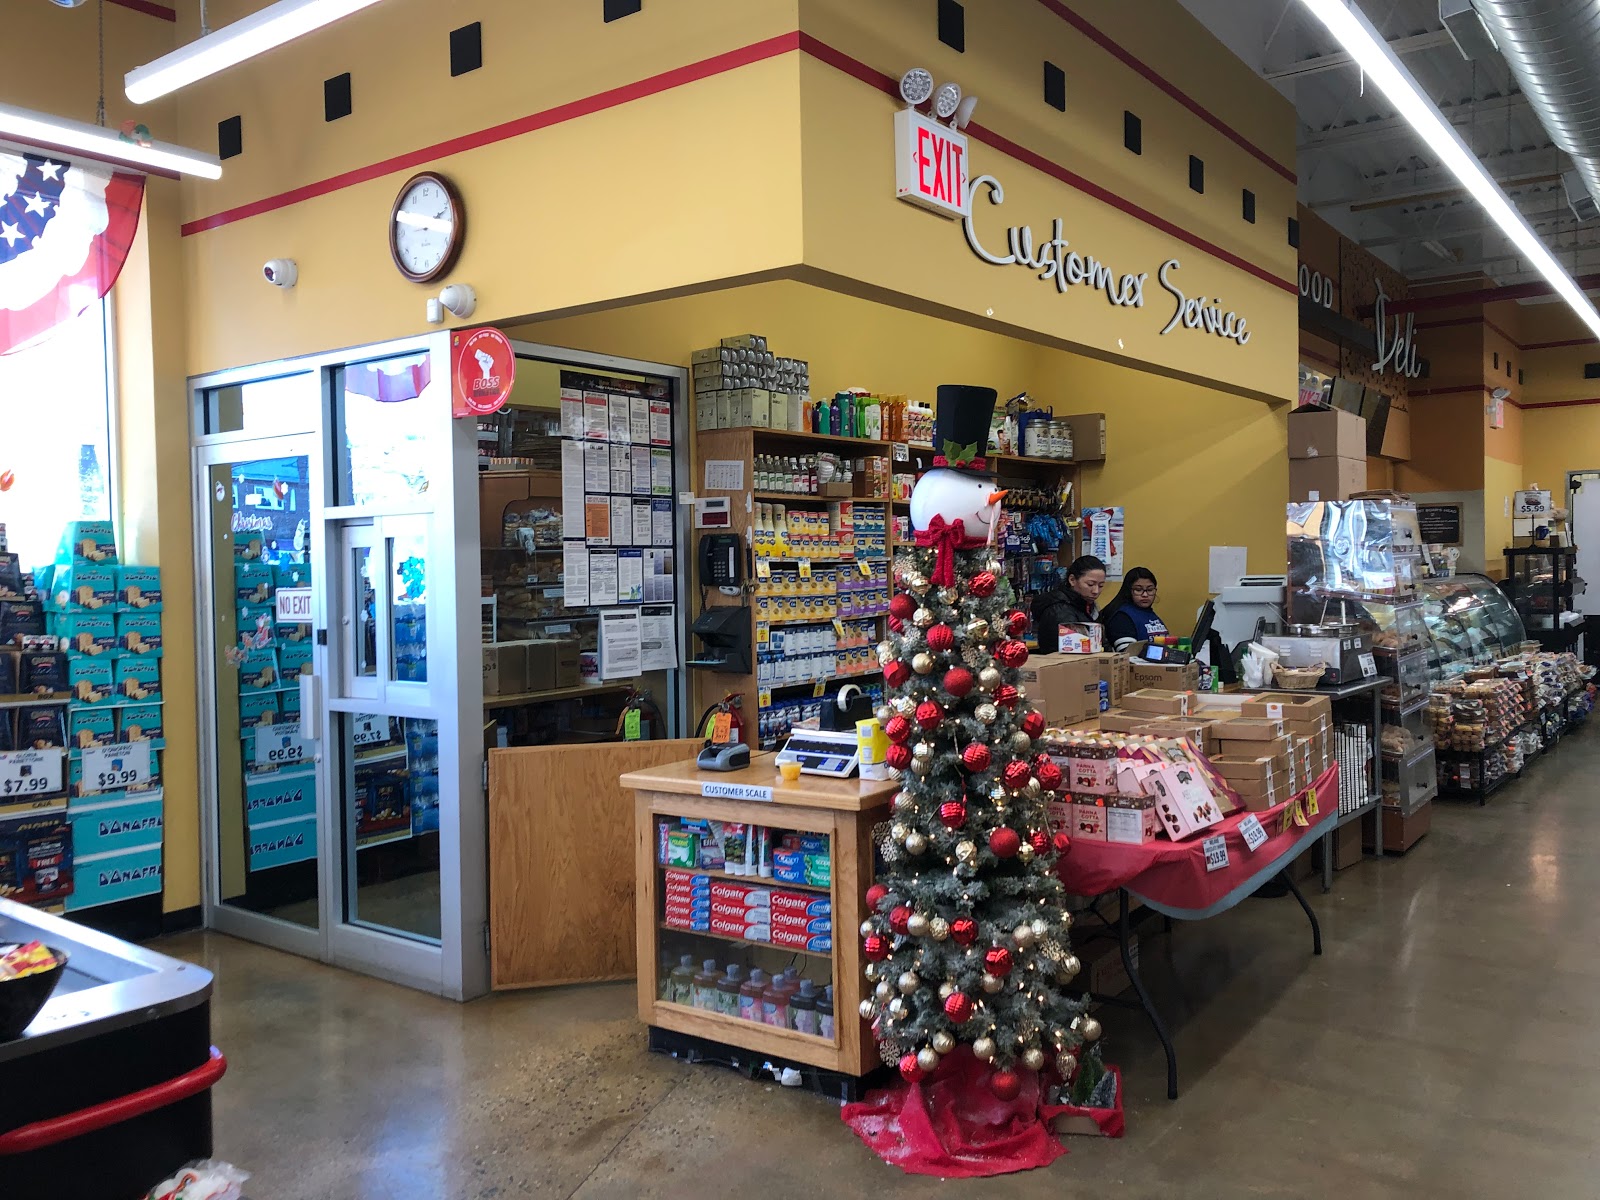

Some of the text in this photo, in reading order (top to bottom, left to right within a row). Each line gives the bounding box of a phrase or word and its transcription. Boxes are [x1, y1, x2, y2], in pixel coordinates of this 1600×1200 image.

[918, 126, 963, 207] EXIT
[961, 174, 1252, 346] Customer Service
[1299, 264, 1333, 309] OOD
[1371, 277, 1422, 378] Deli
[472, 375, 501, 391] BOSS
[1521, 505, 1545, 513] $5.99
[231, 511, 273, 532] Christmas
[279, 595, 311, 614] NO EXIT
[1134, 673, 1162, 684] Epsom
[4, 776, 48, 794] $7.99
[98, 769, 137, 787] $9.99
[704, 785, 767, 799] CUSTOMER SCALE
[666, 871, 690, 881] Colgate
[666, 883, 690, 892] Colgate
[711, 885, 745, 899] Colgate
[666, 893, 691, 903] Colgate
[771, 895, 807, 908] Colgate
[666, 904, 690, 914] Colgate
[711, 902, 745, 915] Colgate
[666, 915, 690, 925] Colgate
[711, 918, 745, 931] Colgate
[772, 912, 807, 926] Colgate
[772, 929, 807, 943] Colgate
